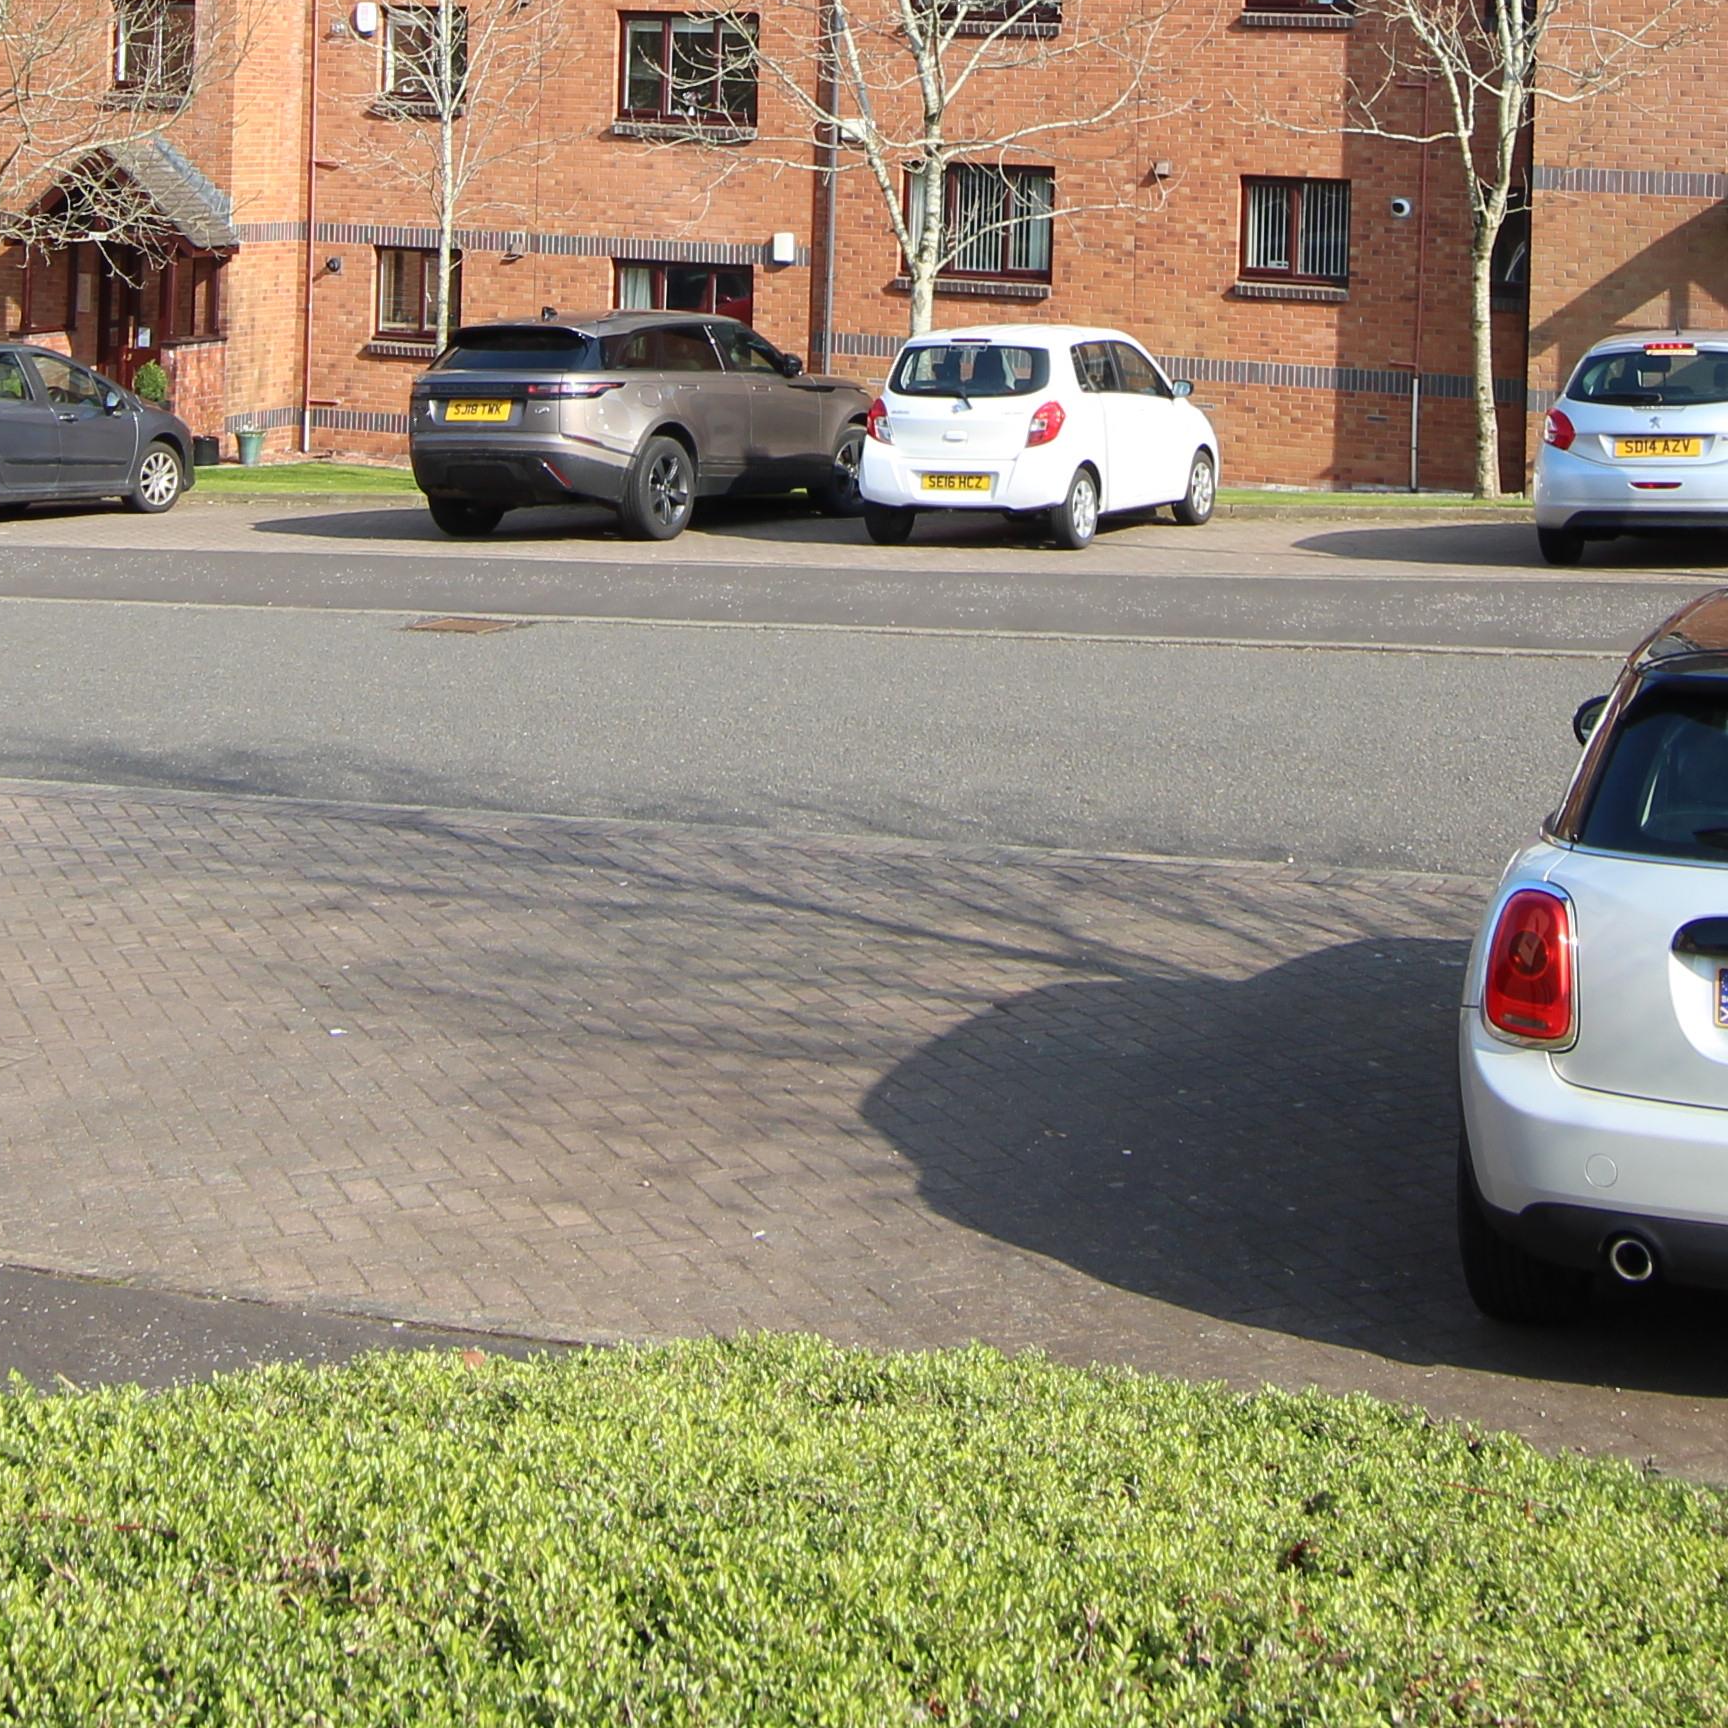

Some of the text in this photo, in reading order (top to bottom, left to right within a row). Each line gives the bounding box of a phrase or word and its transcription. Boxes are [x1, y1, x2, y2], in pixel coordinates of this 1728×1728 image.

[481, 403, 502, 415] TWK
[1624, 439, 1691, 454] SD14 AZV
[928, 475, 983, 489] SE16 HCZ
